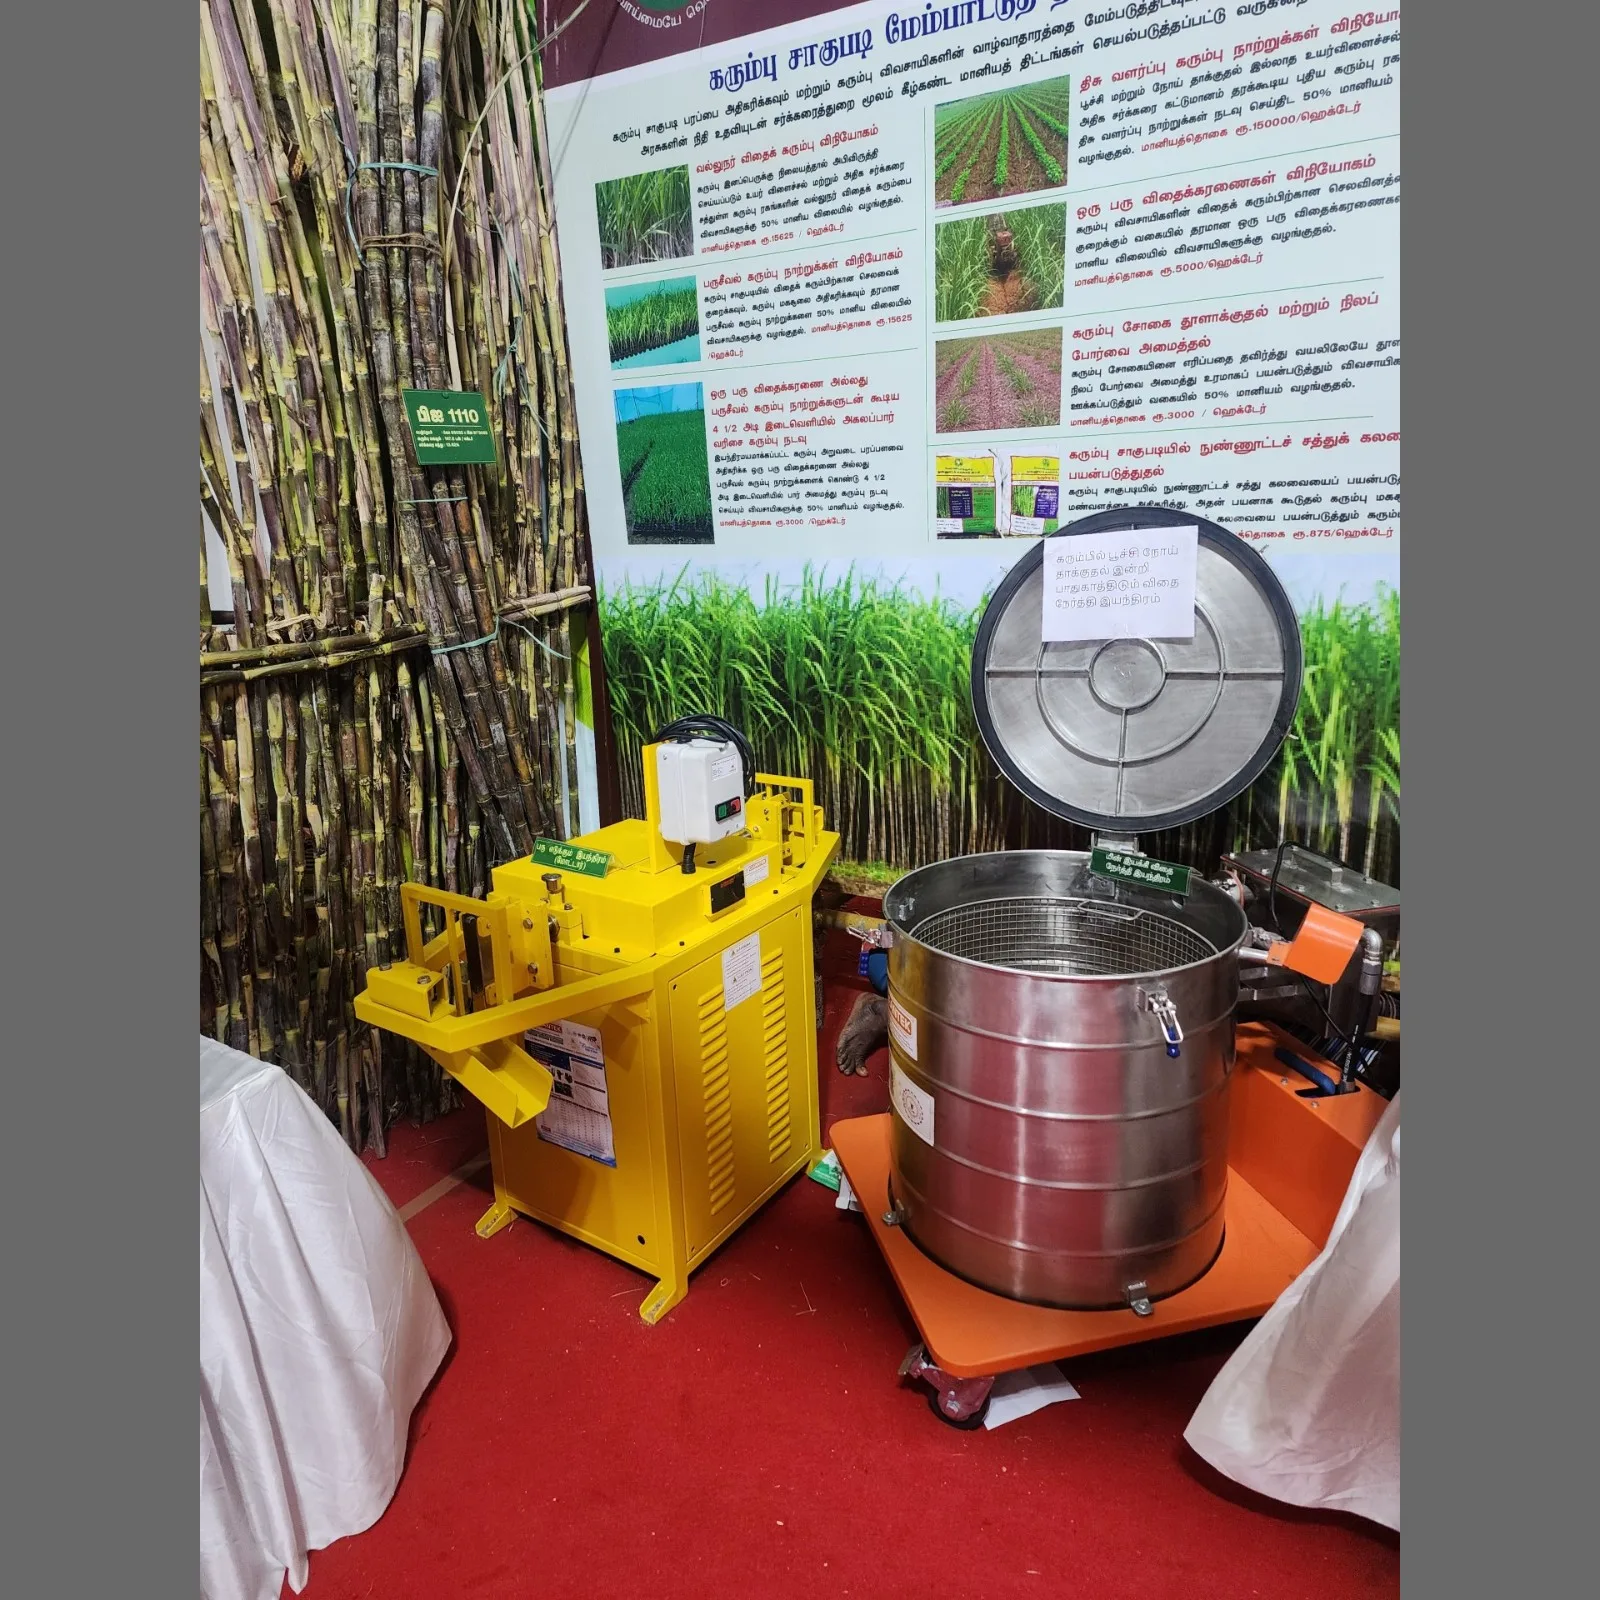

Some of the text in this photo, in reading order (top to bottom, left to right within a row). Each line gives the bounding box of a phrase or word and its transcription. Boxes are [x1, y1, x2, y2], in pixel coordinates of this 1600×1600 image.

[709, 29, 873, 92] கரும்பு சாகுபடி
[1080, 10, 1400, 94] திசு வளர்ப்பு கரும்பு நாற்றுக்கள் விநியோ
[612, 21, 1076, 143] கரும்பு சாகுபடி பரப்பை அதிகரிக்கவும் மற்றும் கரும்பு விவசாயிகளின் வாழ்வாதாரத்தை
[640, 7, 1226, 156] அரசுகளின் நிதி உதவியுடன் சர்க்கரைத்துறை மூலம் கீழ்கண்ட மானியத் திட்டங்கள் செயல்படுத்தப்பட்டு
[1080, 94, 1104, 111] பூச்சி
[1111, 85, 1146, 104] மற்றும்
[1152, 76, 1184, 96] நோய்
[1189, 64, 1243, 88] தாக்குதல்
[1249, 54, 1298, 74] இல்லாத
[1078, 73, 1393, 149] திசு வளர்ப்பு நாற்றுக்கள் நடவு செய்திட 50% மானியம்
[696, 123, 878, 174] வல்லுநர் விதைக் கரும்பு விநியோகம்
[1141, 128, 1228, 152] மானியத்தொகை
[697, 182, 720, 194] கரும்பு
[778, 158, 828, 180] நிலையத்தால்
[832, 148, 879, 166] அபிவிருத்தி
[1076, 153, 1376, 220] ஒரு பரு விதைக்கரணைகள் விநியோகம்
[702, 239, 756, 254] மானியத்தொகை
[806, 223, 844, 238] ஹெக்டேர்
[1075, 256, 1109, 270] மானிய
[1115, 246, 1168, 264] விலையில்
[1174, 234, 1264, 255] விவசாயிகளுக்கு
[704, 247, 903, 290] பருசீவல் கரும்பு நாற்றுக்கள் விநியோகம்
[1074, 270, 1154, 287] மானியத்தொகை
[752, 300, 775, 312] கரும்பு
[815, 287, 866, 304] அதிகரிக்கவும்
[870, 284, 900, 298] தரமான
[1072, 291, 1379, 341] கரும்பு சோகை தூளாக்குதல் மற்றும் நிலப்
[706, 332, 763, 346] விவசாயிகளுக்கு
[811, 320, 872, 333] மானியத்தொகை
[1072, 334, 1211, 362] போர்வை அமைத்தல்
[710, 375, 868, 401] ஒரு பரு விதைக்கரணை அல்லது
[1070, 396, 1143, 410] ஊக்கப்படுத்தும்
[1149, 391, 1198, 404] வகையில்
[1204, 390, 1229, 400] 50%
[1236, 384, 1283, 397] மானியம்
[448, 409, 479, 423] 1110
[712, 393, 900, 418] பருசீவல் கரும்பு நாற்றுக்களுடன் கூடிய
[1070, 414, 1146, 427] மானியத்தொகை
[1212, 402, 1267, 418] ஹெக்டேர்
[712, 410, 894, 434] 4 1/2 அடி இடைவெளியில் அகலப்பார்
[713, 434, 807, 450] வரிசை கரும்பு நடவு
[1069, 431, 1350, 462] கரும்பு சாகுபடியில் நுண்ணூட்டச் சத்துக்
[715, 460, 870, 476] அதிகரிக்க ஒரு பரு விதைக்கரணை அல்லது
[1068, 464, 1164, 482] பயன்படுத்துதல்
[717, 488, 888, 502] அடி இடைவெளியில் பார் அமைத்து கரும்பு நடவு
[720, 518, 772, 528] மானியத்தொகை
[1056, 544, 1178, 565] கரும்பில் பூச்சி நோய்
[1056, 562, 1150, 580] தாக்குதல் இன்றி
[1056, 576, 1180, 596] பாதுகாத்திடும் விதை
[1055, 592, 1160, 609] நேர்த்தி இயந்திரம்
[576, 850, 607, 864] இயந்திரம்
